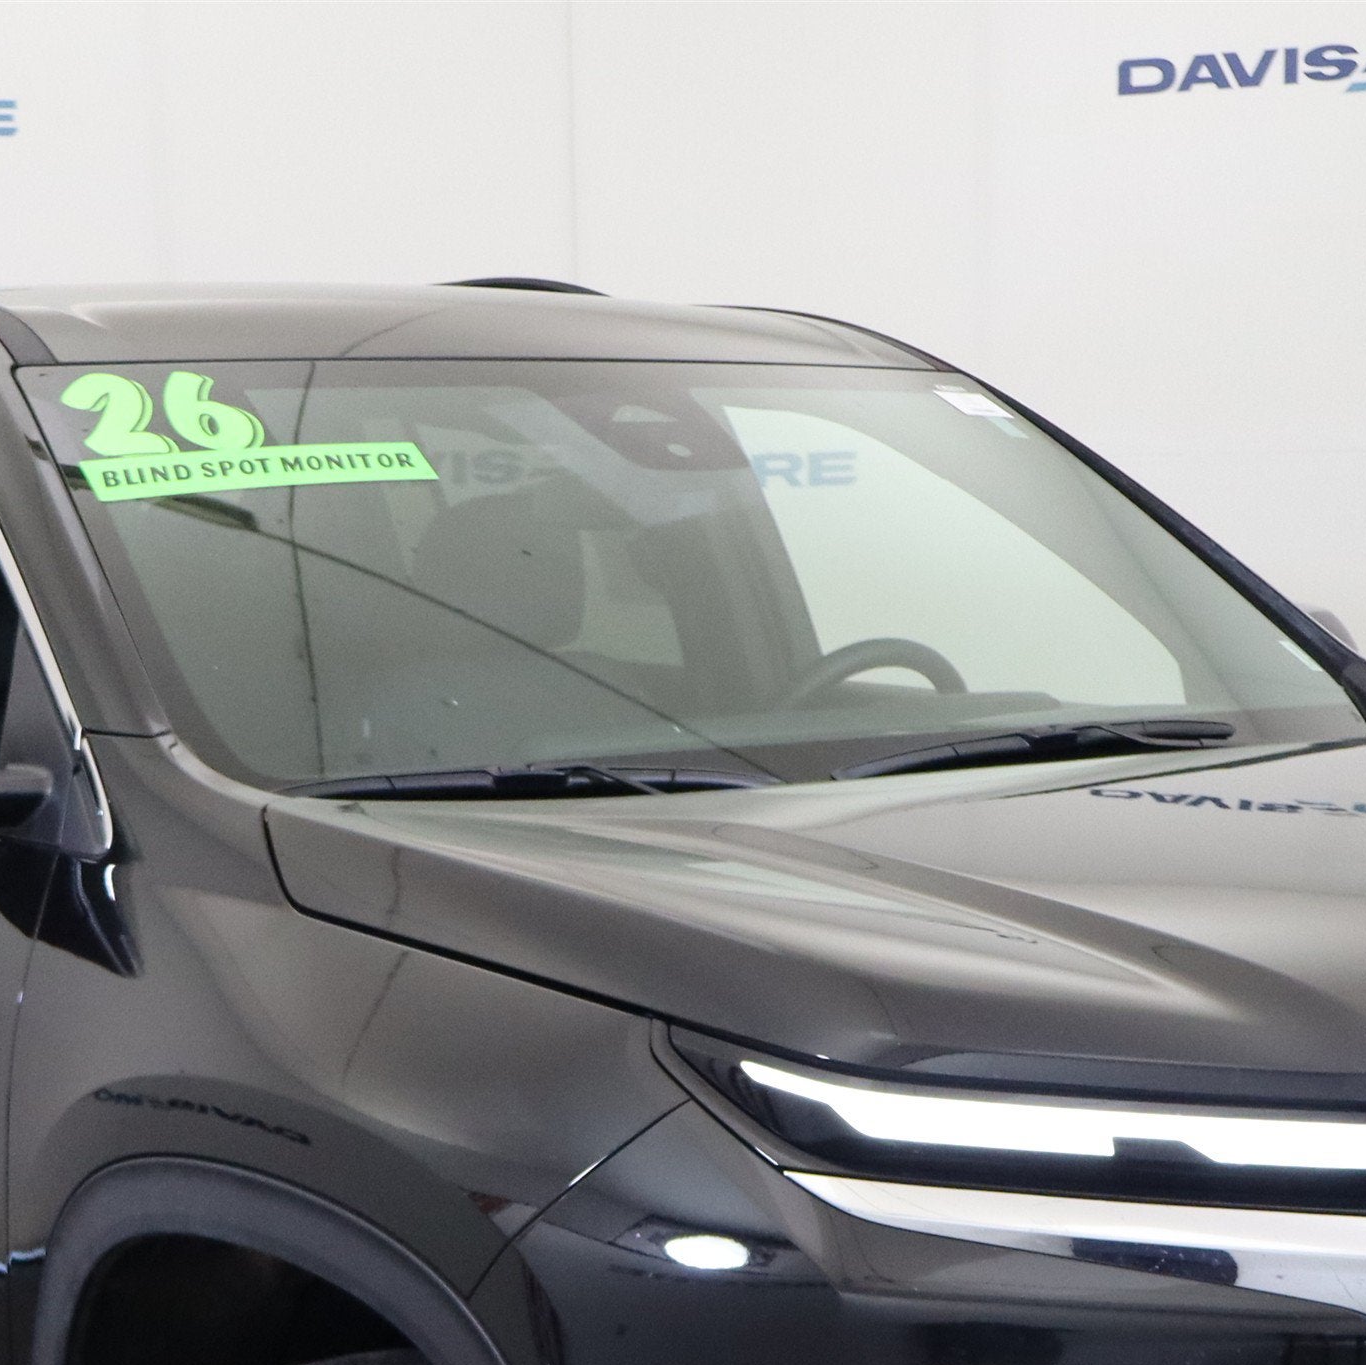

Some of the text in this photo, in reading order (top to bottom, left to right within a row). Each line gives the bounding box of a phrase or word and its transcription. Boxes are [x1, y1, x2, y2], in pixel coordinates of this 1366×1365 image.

[1117, 45, 1360, 96] DAVIS
[60, 370, 265, 456] 26
[101, 451, 416, 489] BLIND SPOT MONITOR
